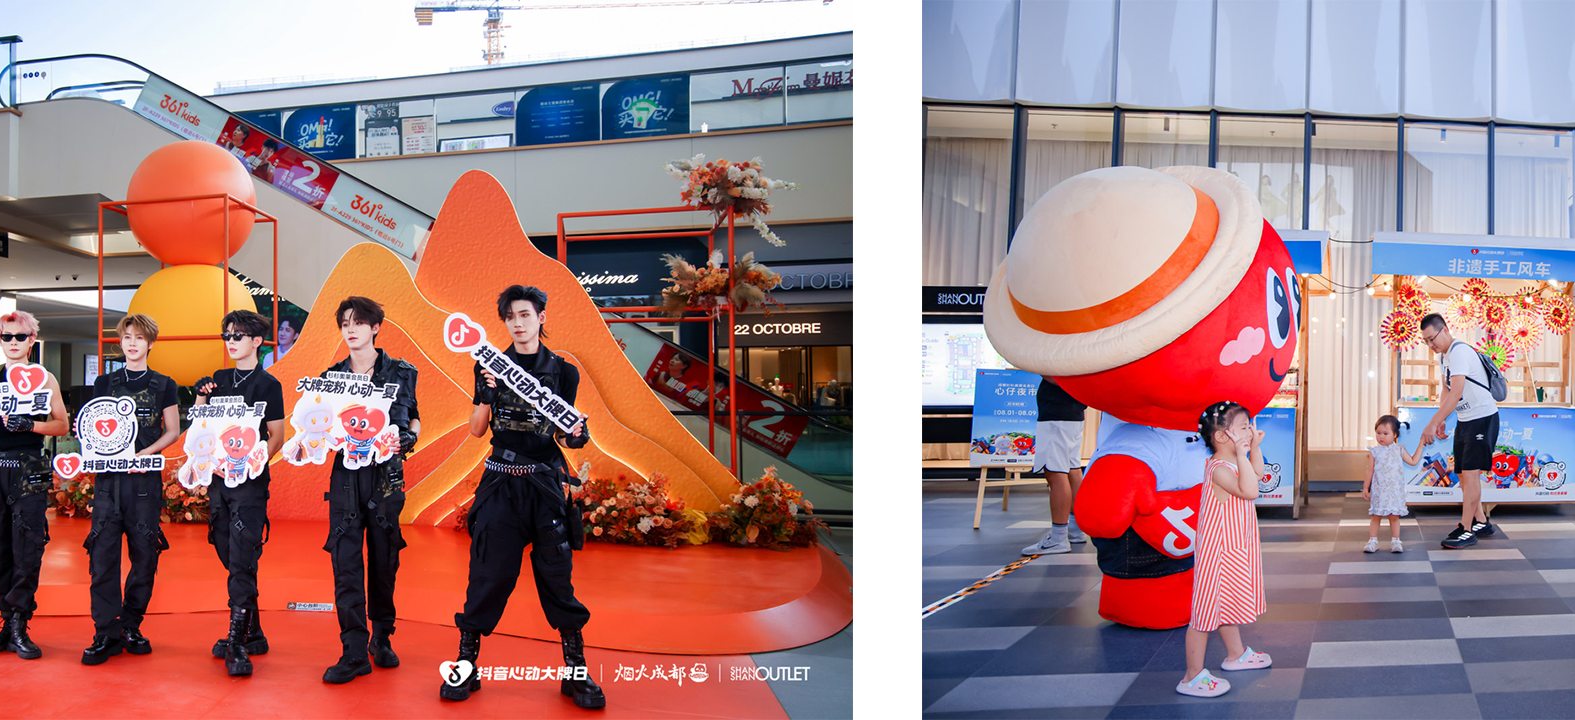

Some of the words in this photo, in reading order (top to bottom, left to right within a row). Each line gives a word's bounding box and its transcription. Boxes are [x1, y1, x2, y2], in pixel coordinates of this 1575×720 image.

[159, 94, 189, 116] 361°
[180, 109, 201, 127] kids
[300, 118, 333, 137] OMG!
[292, 160, 327, 199] 2折
[330, 206, 352, 220] 2F-A229
[350, 194, 384, 218] 361°
[374, 211, 397, 230] kids
[1448, 258, 1551, 277] 非遗手工风车
[734, 325, 750, 336] 22
[752, 323, 822, 335] OCTOBRE
[327, 372, 369, 382] 杉杉奥莱会员日
[297, 378, 346, 394] 大牌宠粉
[347, 382, 400, 400] 心动一夏
[474, 344, 578, 430] 抖音心动大牌日
[995, 387, 1037, 396] 心仔夜市
[187, 404, 226, 419] 大牌宠粉
[226, 403, 266, 419] 心动一夏
[747, 399, 793, 447] 2折
[82, 457, 163, 471] 抖音心动大牌日
